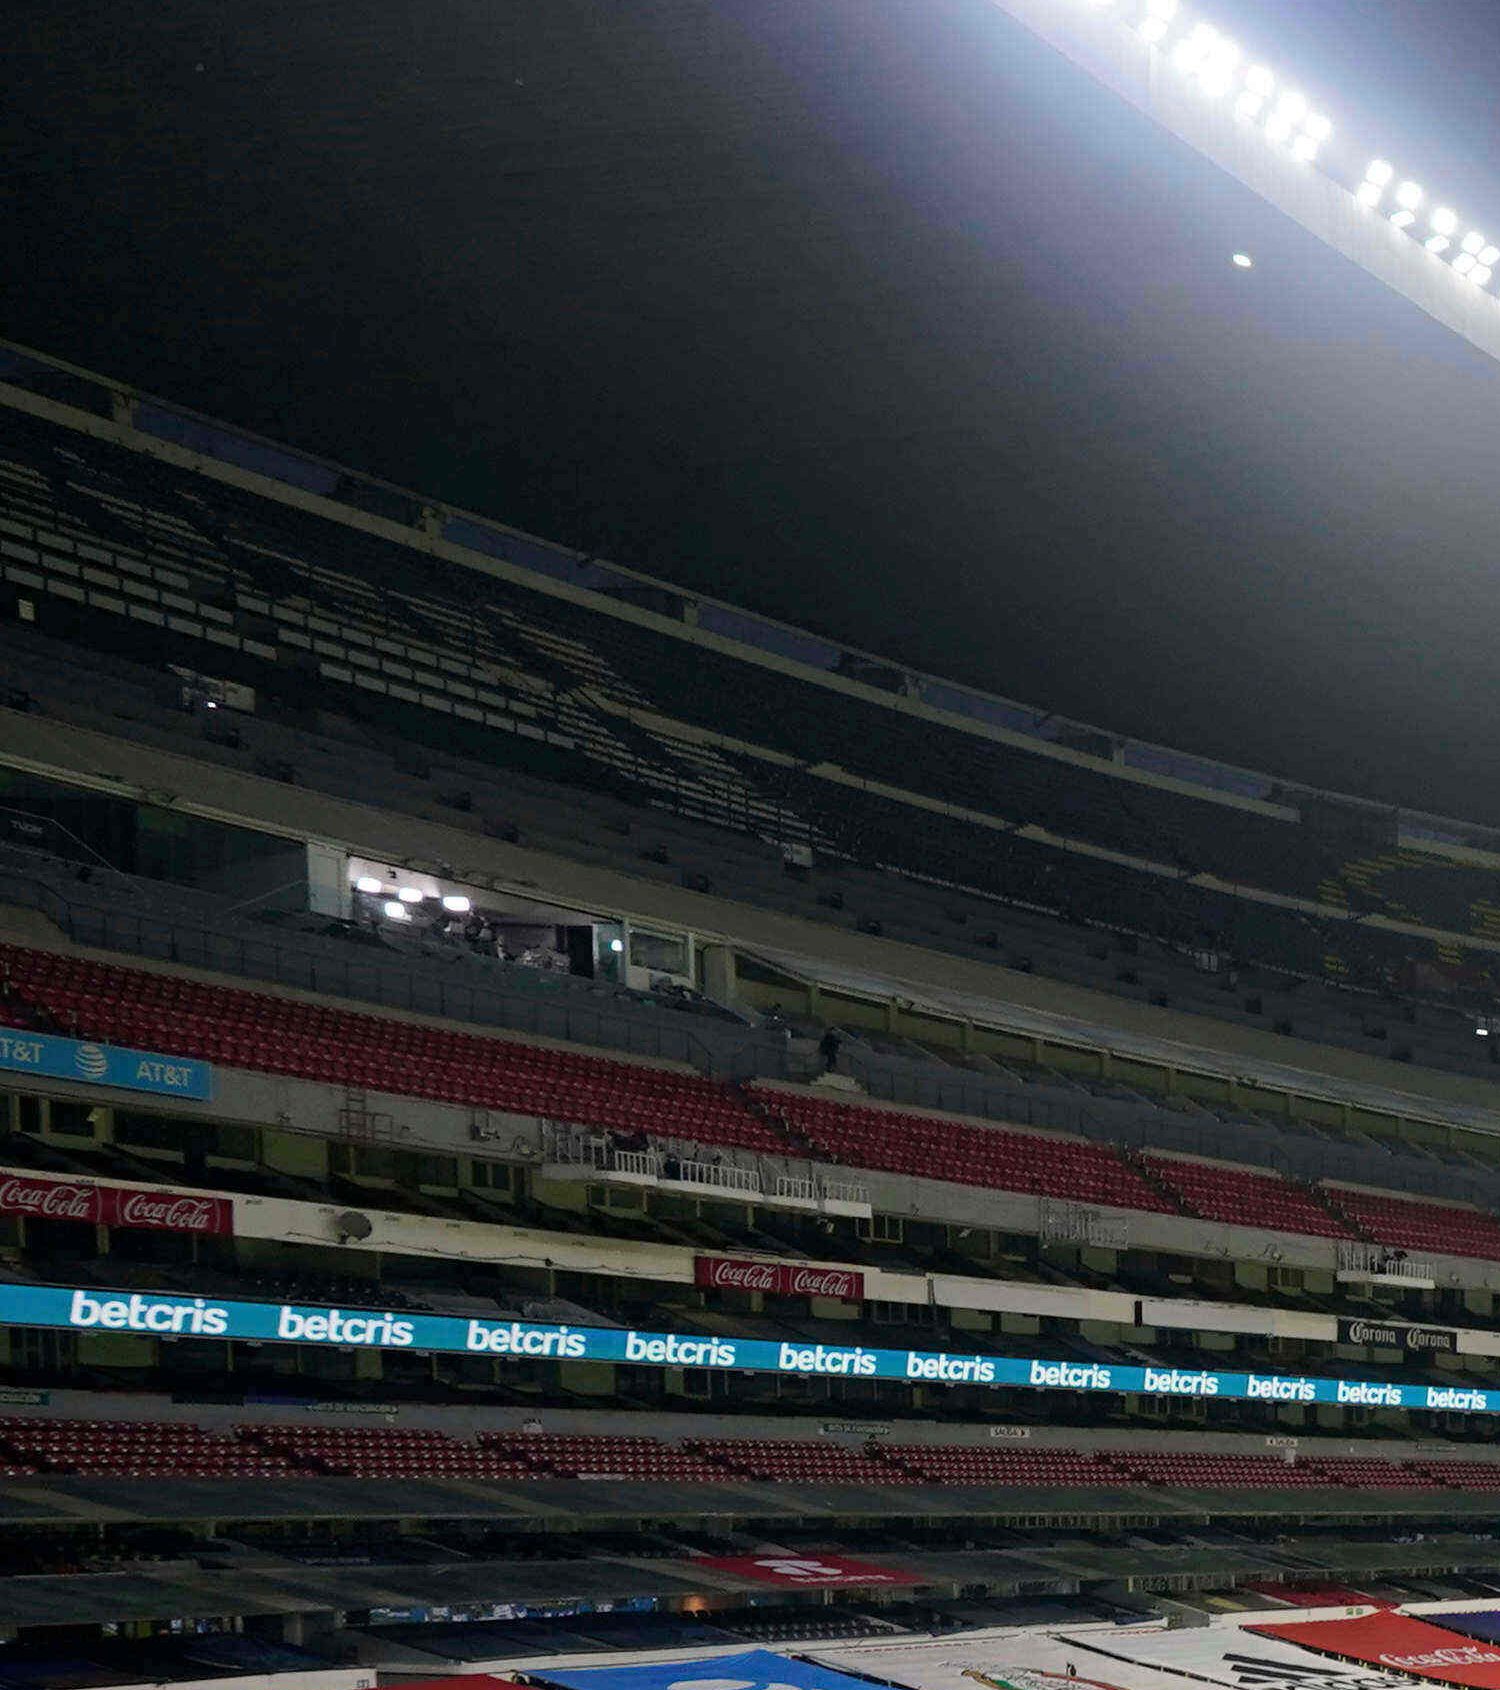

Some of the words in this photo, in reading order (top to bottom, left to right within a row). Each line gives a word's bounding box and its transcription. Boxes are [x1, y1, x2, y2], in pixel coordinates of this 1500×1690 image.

[0, 1036, 44, 1063] T&T
[136, 1060, 192, 1088] AT&T
[70, 1290, 230, 1336] betcris
[278, 1305, 414, 1347] betcris
[465, 1320, 587, 1359] betcris
[1349, 1320, 1396, 1345] Corona
[1407, 1326, 1451, 1351] Corona
[625, 1332, 737, 1368] betcris
[779, 1343, 878, 1376] betcris
[906, 1351, 996, 1383] betcris
[1029, 1359, 1112, 1390] betcris
[1144, 1367, 1219, 1396] betcris
[1247, 1374, 1317, 1402] betcris
[1337, 1380, 1403, 1407] betcris
[1426, 1386, 1488, 1411] betcris
